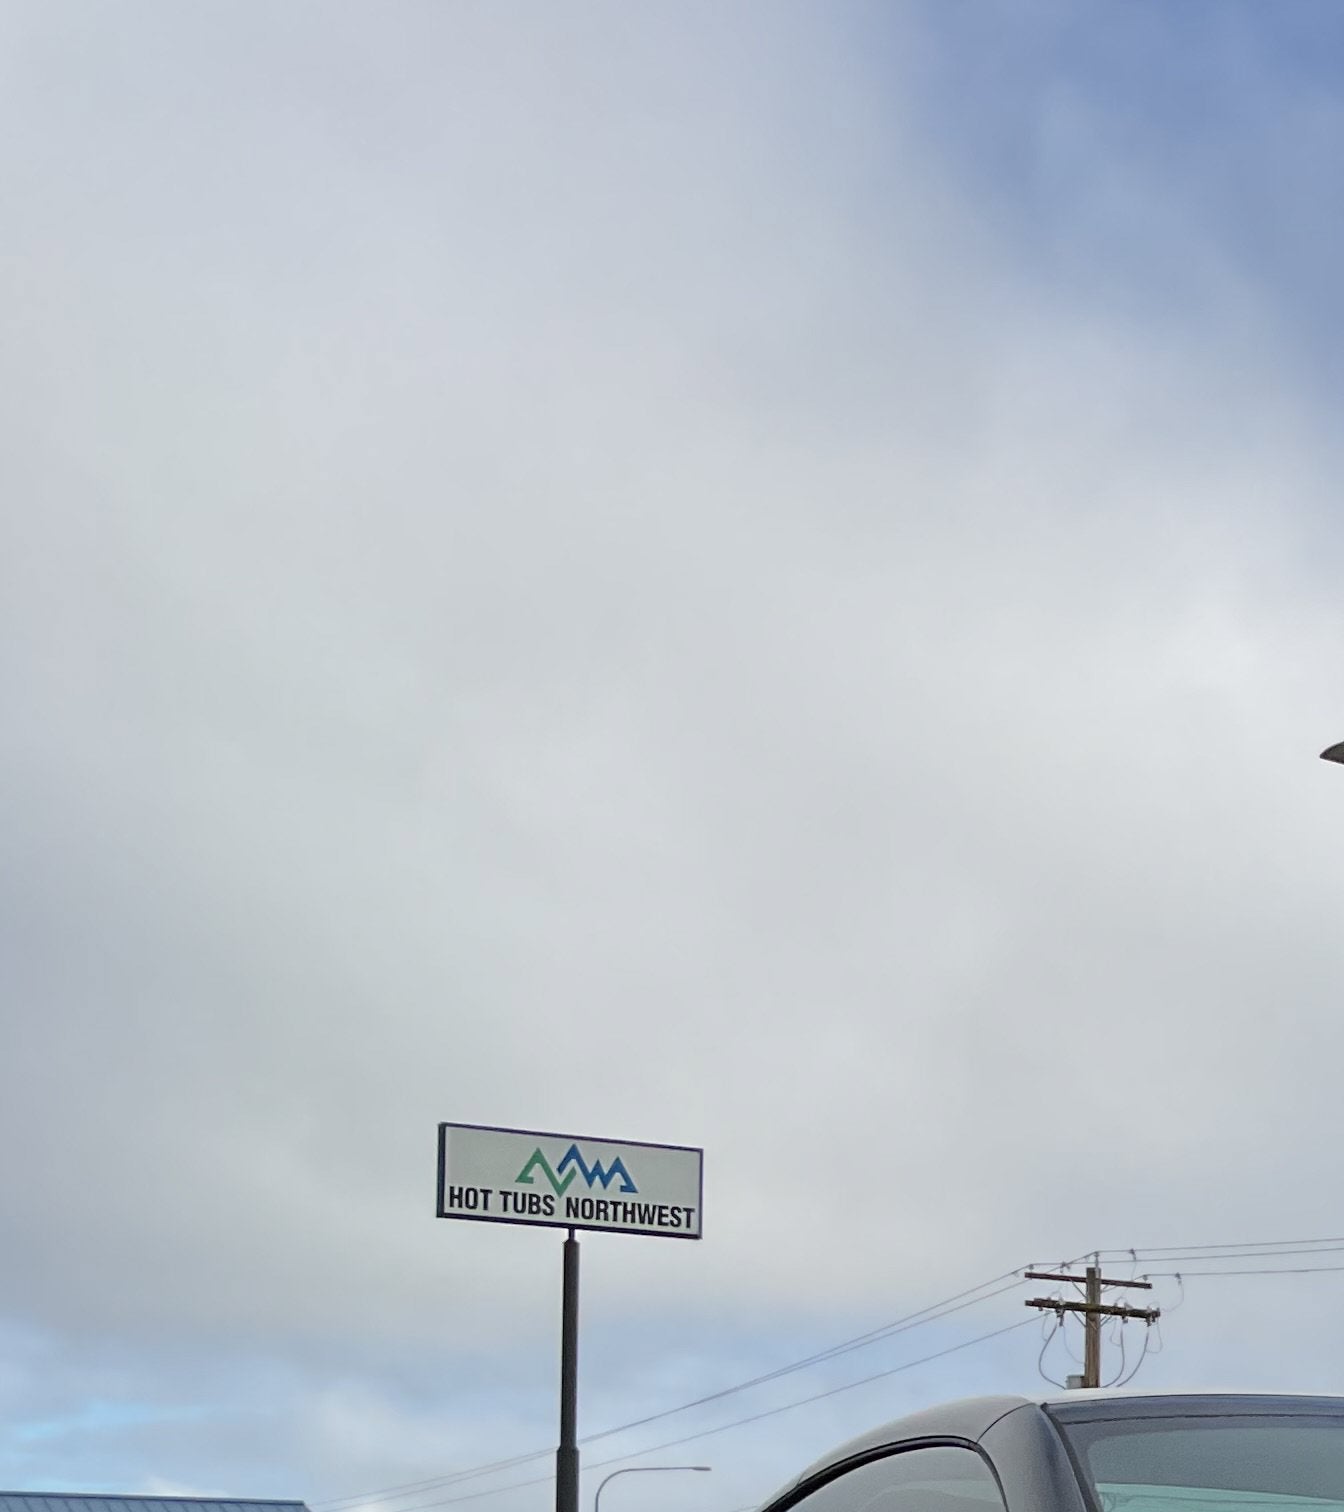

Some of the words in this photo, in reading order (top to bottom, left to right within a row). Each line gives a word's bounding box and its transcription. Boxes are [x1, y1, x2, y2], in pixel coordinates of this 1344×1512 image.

[449, 1186, 492, 1210] HOT
[499, 1190, 555, 1216] TUBS
[566, 1197, 695, 1228] NORTHWEST
